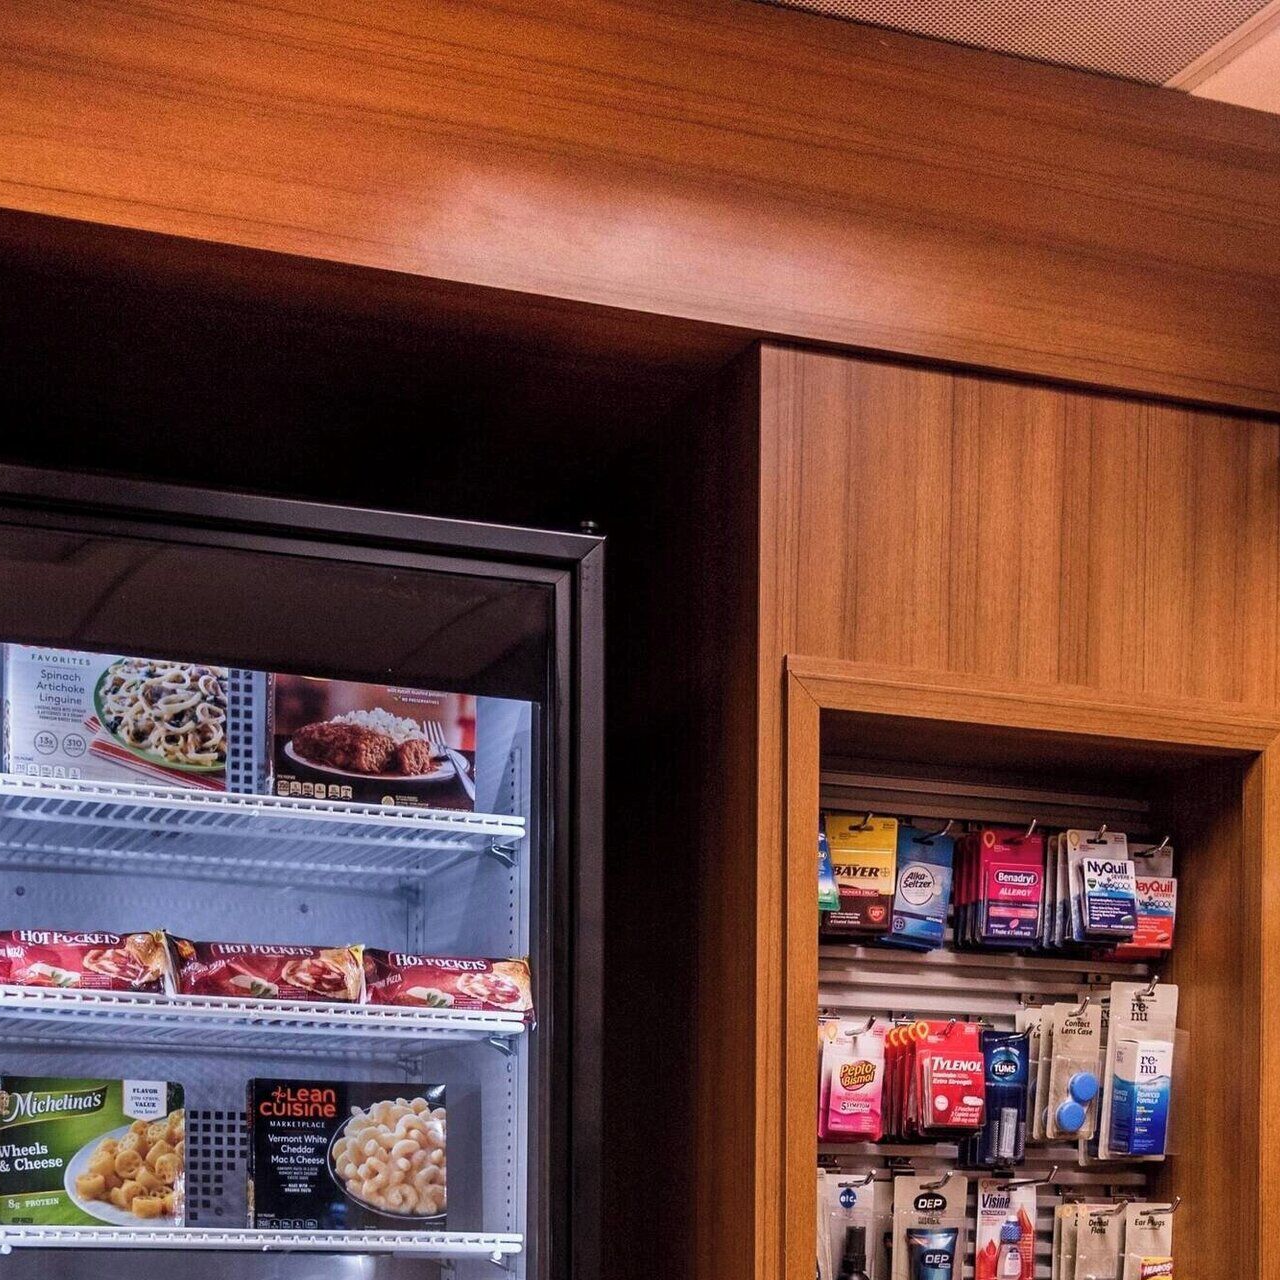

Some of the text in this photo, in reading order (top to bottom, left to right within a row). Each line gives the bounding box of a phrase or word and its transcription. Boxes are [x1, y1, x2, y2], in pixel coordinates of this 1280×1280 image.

[31, 654, 92, 666] FAVORITES
[40, 669, 82, 683] Spinach
[36, 681, 86, 695] Artichoke
[39, 694, 82, 707] Linguine
[834, 866, 880, 878] BAYER
[1087, 860, 1127, 876] NyQuil
[907, 872, 929, 882] Alka-
[996, 872, 1036, 884] Benadryl
[903, 878, 932, 889] Seltzer
[998, 887, 1032, 897] ALLERGY
[19, 930, 50, 944] HOT
[218, 944, 249, 955] HOT
[395, 953, 422, 965] HOT
[1064, 1019, 1090, 1028] Contact
[1061, 1027, 1093, 1036] Lens Case
[840, 1064, 876, 1077] Pepto-
[932, 1057, 982, 1072] TYLENOL
[993, 1063, 1016, 1074] TUMS
[842, 1073, 875, 1087] Bismol
[287, 1088, 336, 1102] Lean
[3, 1092, 101, 1122] Michelina's
[268, 1134, 327, 1144] Vermont White
[281, 1145, 315, 1154] Cheddar
[0, 1158, 63, 1172] & Cheese
[271, 1155, 324, 1164] Mac & Cheese
[26, 1198, 59, 1208] PROTEIN
[918, 1199, 942, 1209] DEP
[982, 1194, 1010, 1209] Visine
[925, 1254, 949, 1264] DEP
